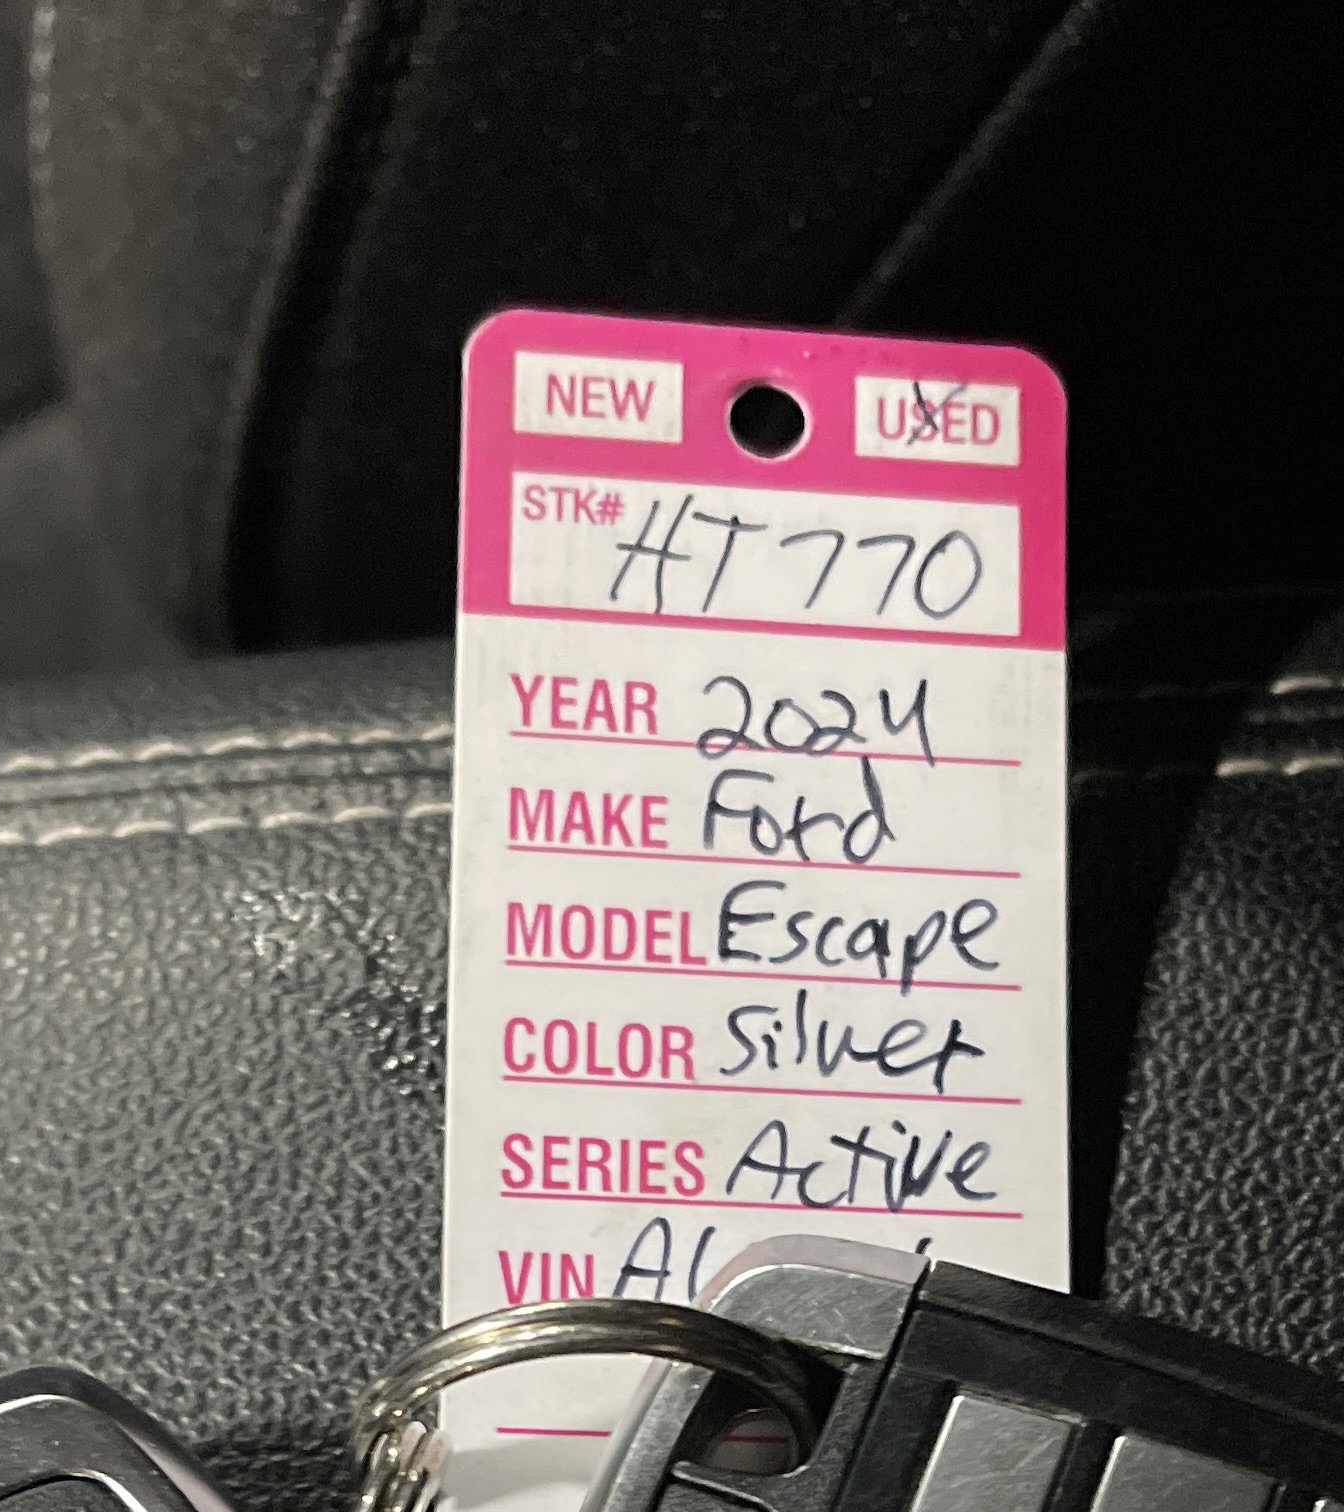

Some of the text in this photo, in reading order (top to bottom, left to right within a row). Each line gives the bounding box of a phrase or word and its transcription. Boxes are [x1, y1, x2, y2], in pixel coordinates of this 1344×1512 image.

[545, 373, 654, 422] NEW
[877, 396, 1002, 446] USED
[521, 484, 624, 525] STK#
[511, 673, 657, 734] YEAR
[697, 676, 934, 767] 2024
[508, 786, 668, 848] MAKE
[702, 756, 896, 864] Ford
[505, 901, 708, 966] MODEL
[716, 879, 1000, 994] Escape
[503, 1016, 695, 1082] COLOR
[718, 988, 986, 1095] Silver
[500, 1132, 706, 1196] SERIES
[725, 1118, 997, 1213] Active
[497, 1249, 596, 1306] VIN
